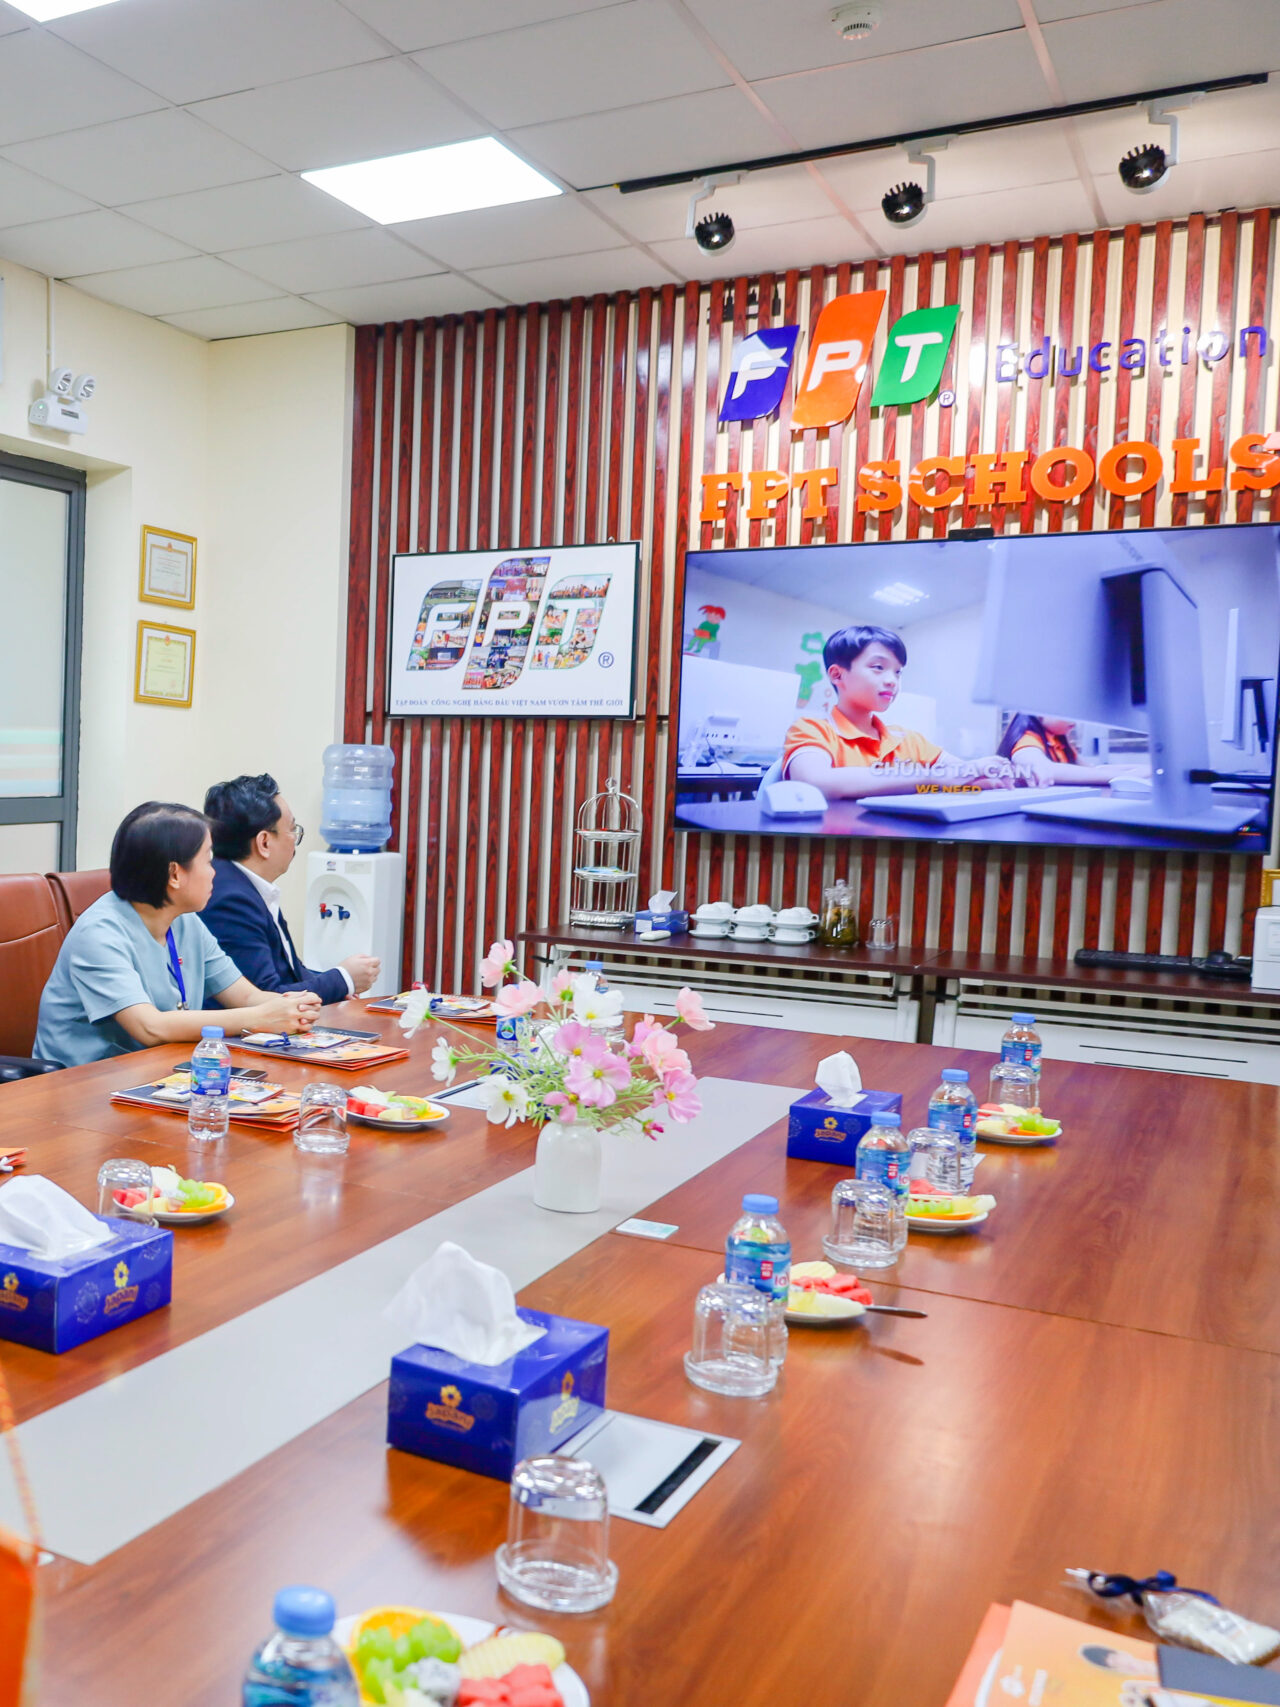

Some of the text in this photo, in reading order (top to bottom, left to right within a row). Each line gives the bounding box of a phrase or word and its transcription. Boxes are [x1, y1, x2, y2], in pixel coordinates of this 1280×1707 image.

[996, 325, 1267, 382] Education
[699, 431, 1280, 522] FPT SCHOOLS
[948, 763, 979, 779] TA
[916, 784, 982, 795] WE NEED
